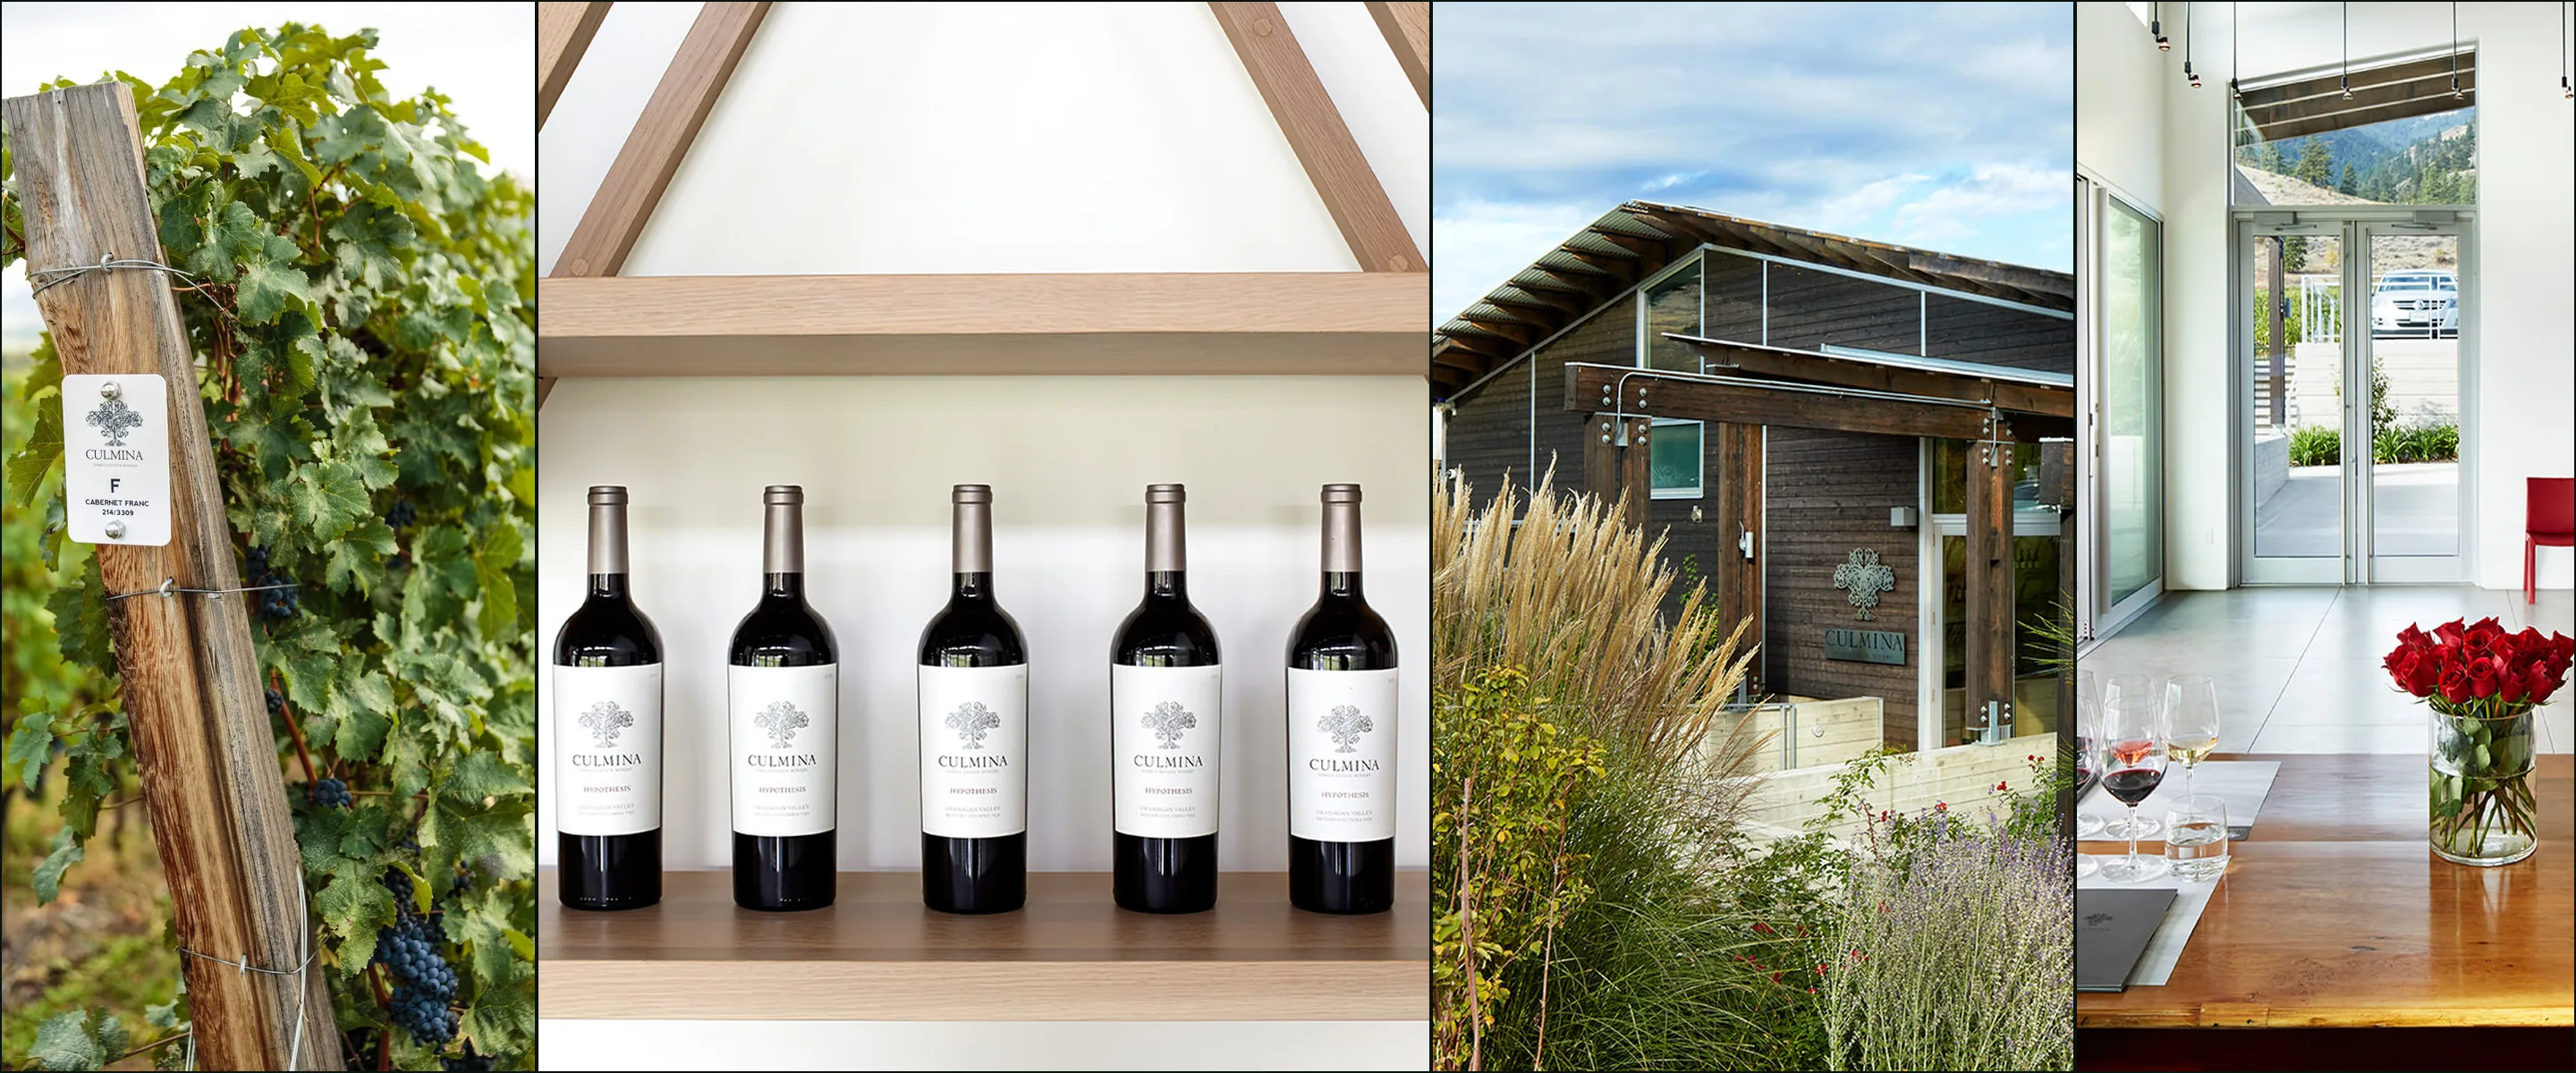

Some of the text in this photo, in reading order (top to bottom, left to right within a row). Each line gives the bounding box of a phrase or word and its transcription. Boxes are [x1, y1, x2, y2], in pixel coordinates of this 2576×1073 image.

[85, 449, 143, 460] CULMINA
[110, 478, 121, 493] F
[1825, 629, 1902, 652] CULMINA
[572, 754, 642, 767] CULMINA
[748, 754, 817, 767] CULMINA
[938, 755, 1009, 768] CULMINA
[1133, 755, 1204, 768] CULMINA
[1309, 758, 1380, 772] CULMINA
[758, 786, 807, 794] HYPOTHESIS
[950, 787, 997, 795] HYPOTHESIS
[1145, 787, 1193, 795] HYPOTHESIS
